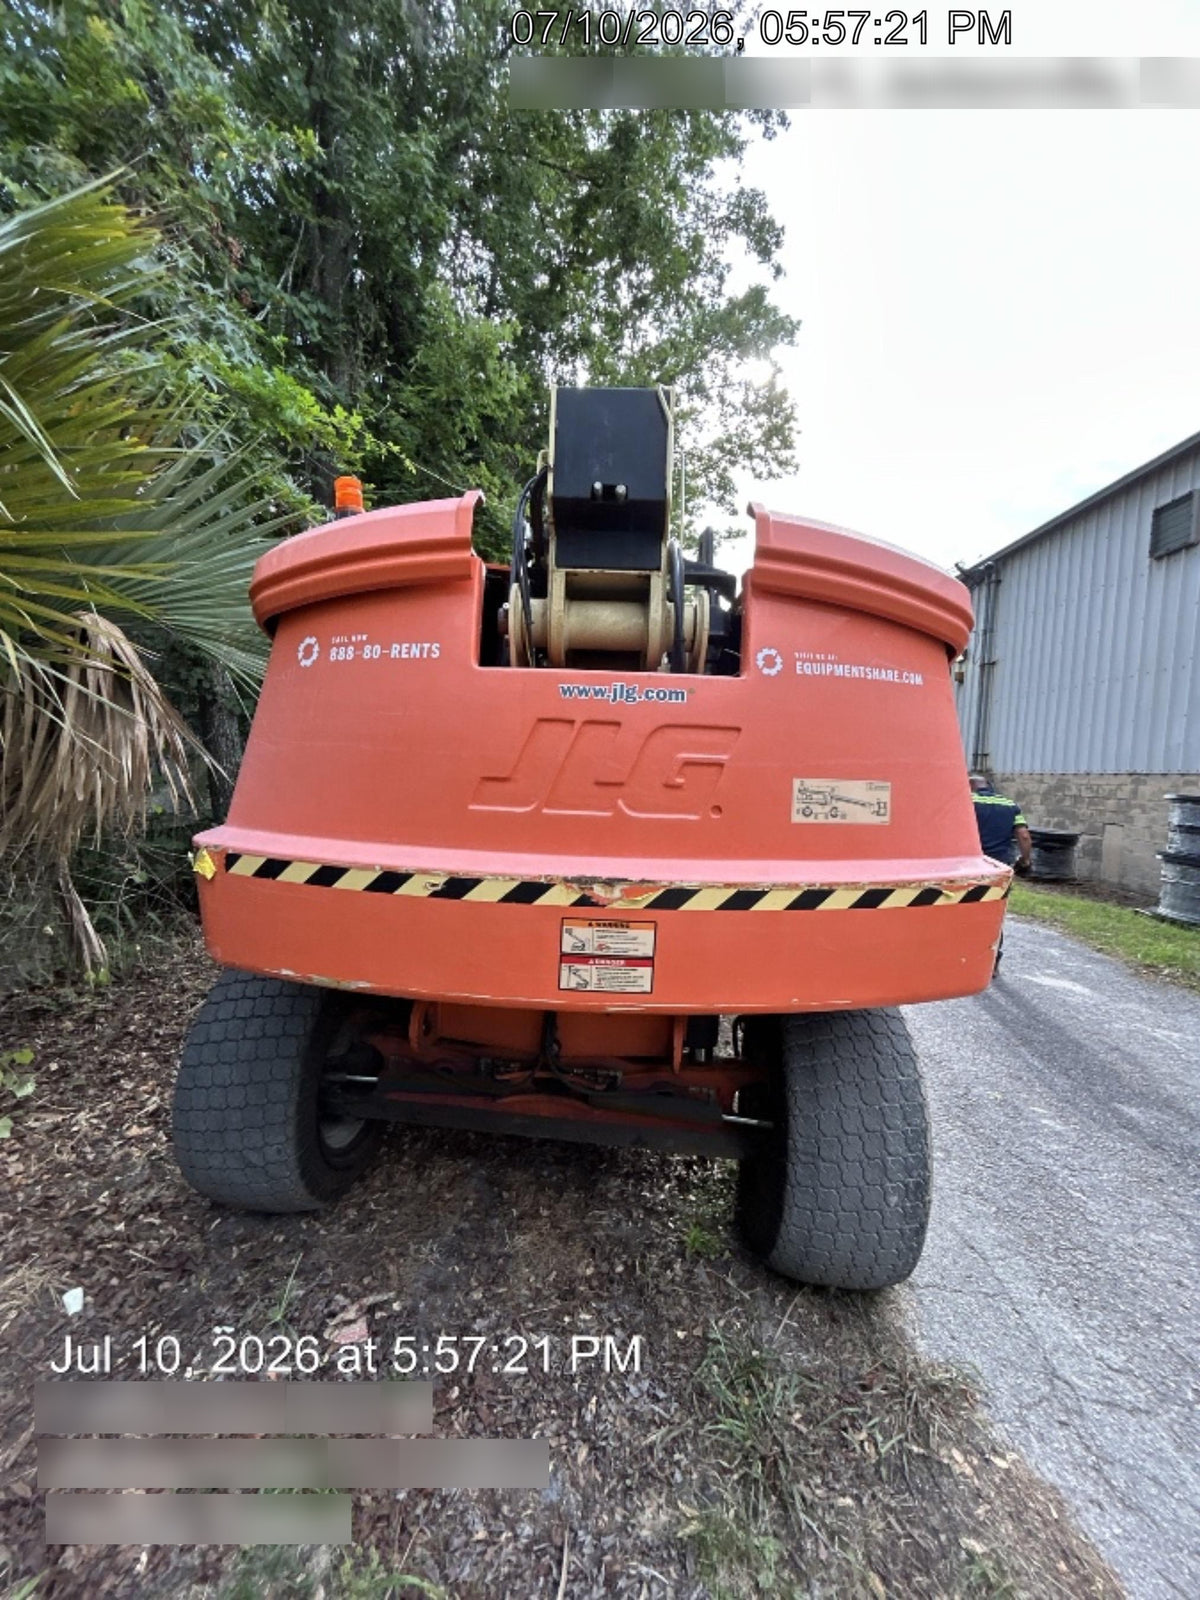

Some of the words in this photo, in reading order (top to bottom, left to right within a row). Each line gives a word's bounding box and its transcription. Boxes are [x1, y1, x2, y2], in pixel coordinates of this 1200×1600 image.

[329, 643, 441, 661] 888-80-RENTS
[795, 661, 924, 686] EQUIPMENTSHARE.COM
[558, 683, 687, 704] www.jlg.com
